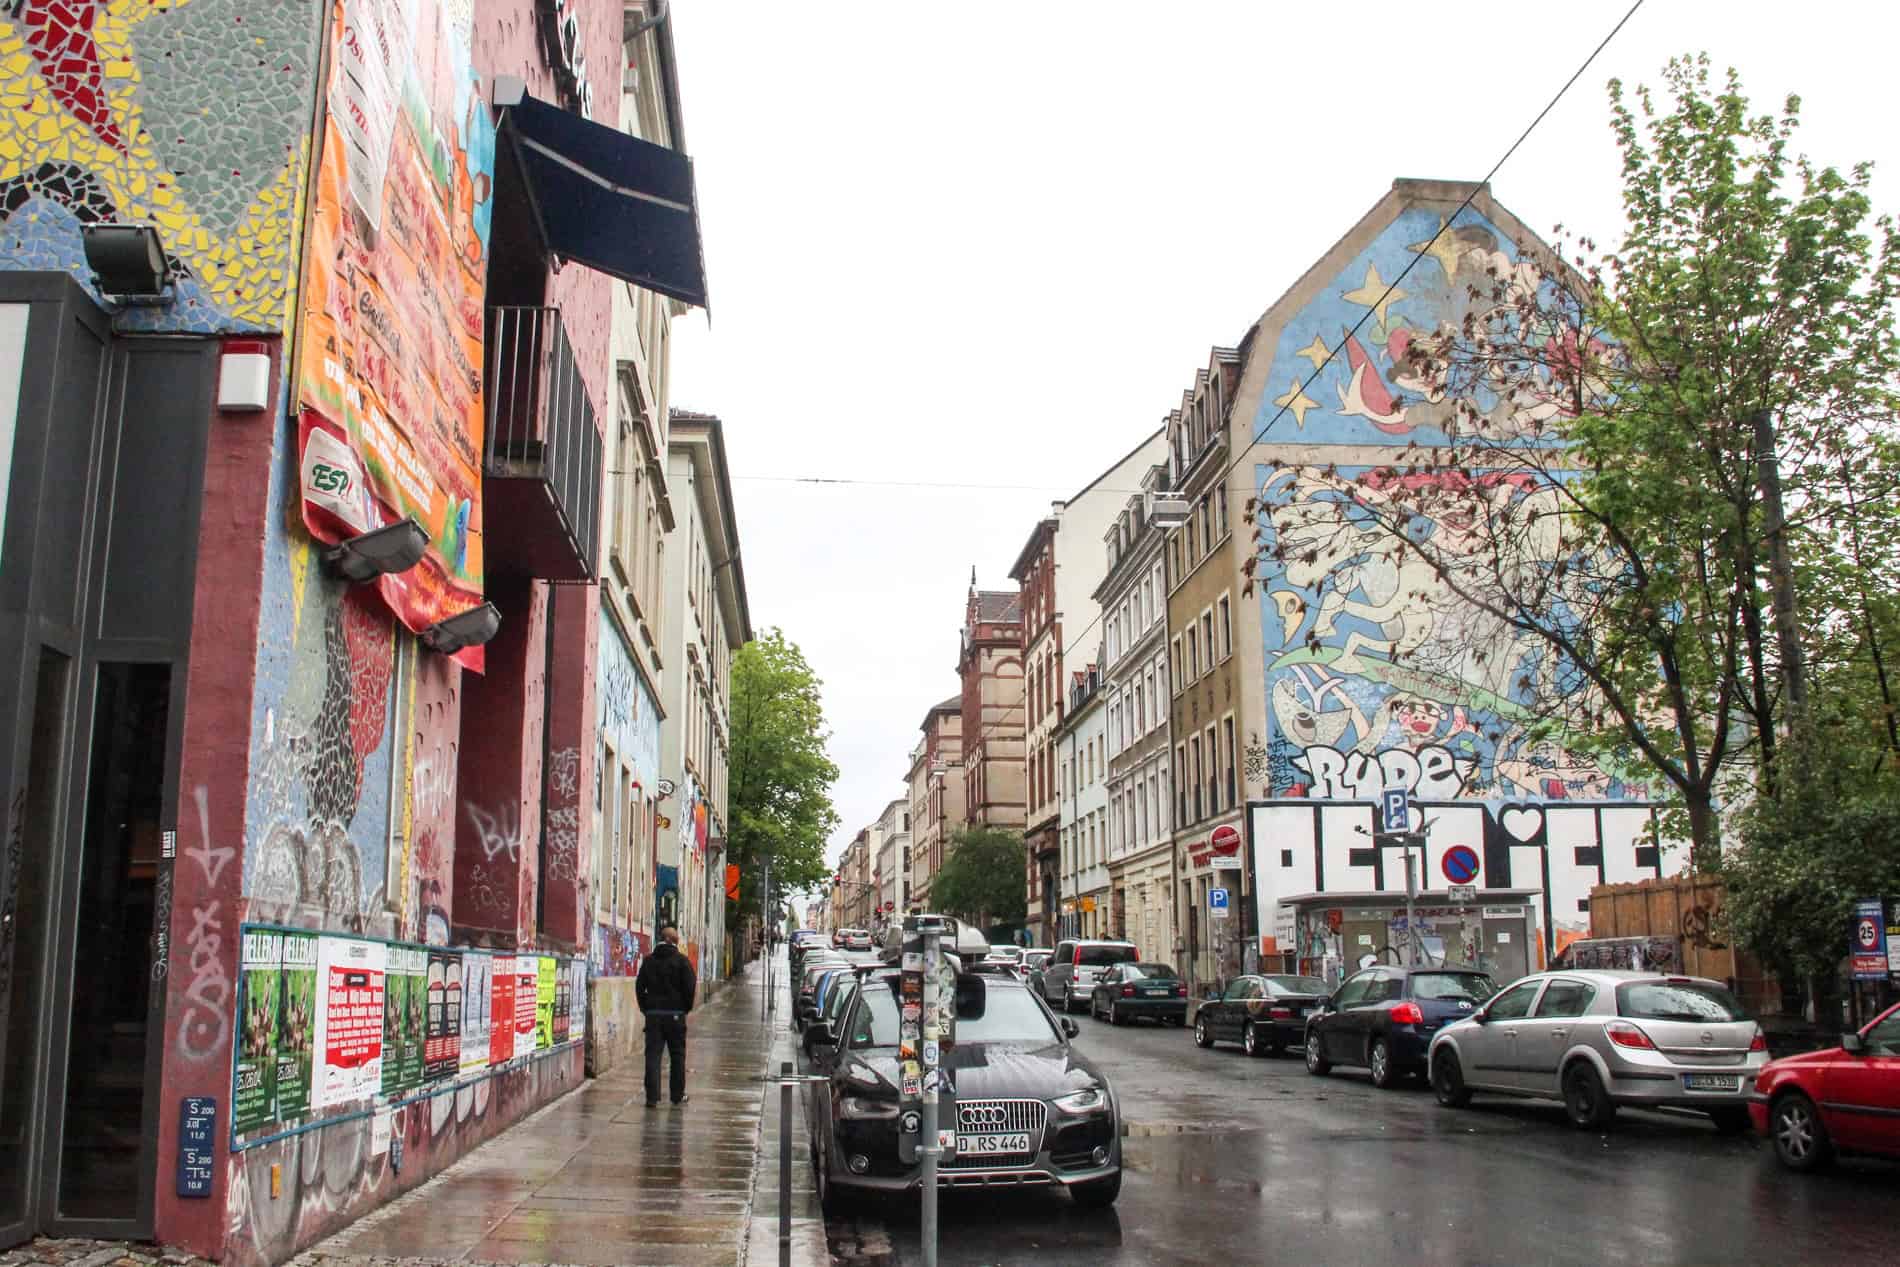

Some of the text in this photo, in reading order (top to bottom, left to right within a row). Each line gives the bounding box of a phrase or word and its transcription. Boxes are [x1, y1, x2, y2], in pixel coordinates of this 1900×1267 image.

[1388, 794, 1404, 816] P
[1213, 891, 1224, 906] P
[1860, 926, 1874, 940] 25
[190, 1103, 215, 1115] S 200
[978, 1137, 997, 1152] RS
[1000, 1136, 1027, 1150] 446
[187, 1152, 195, 1164] S
